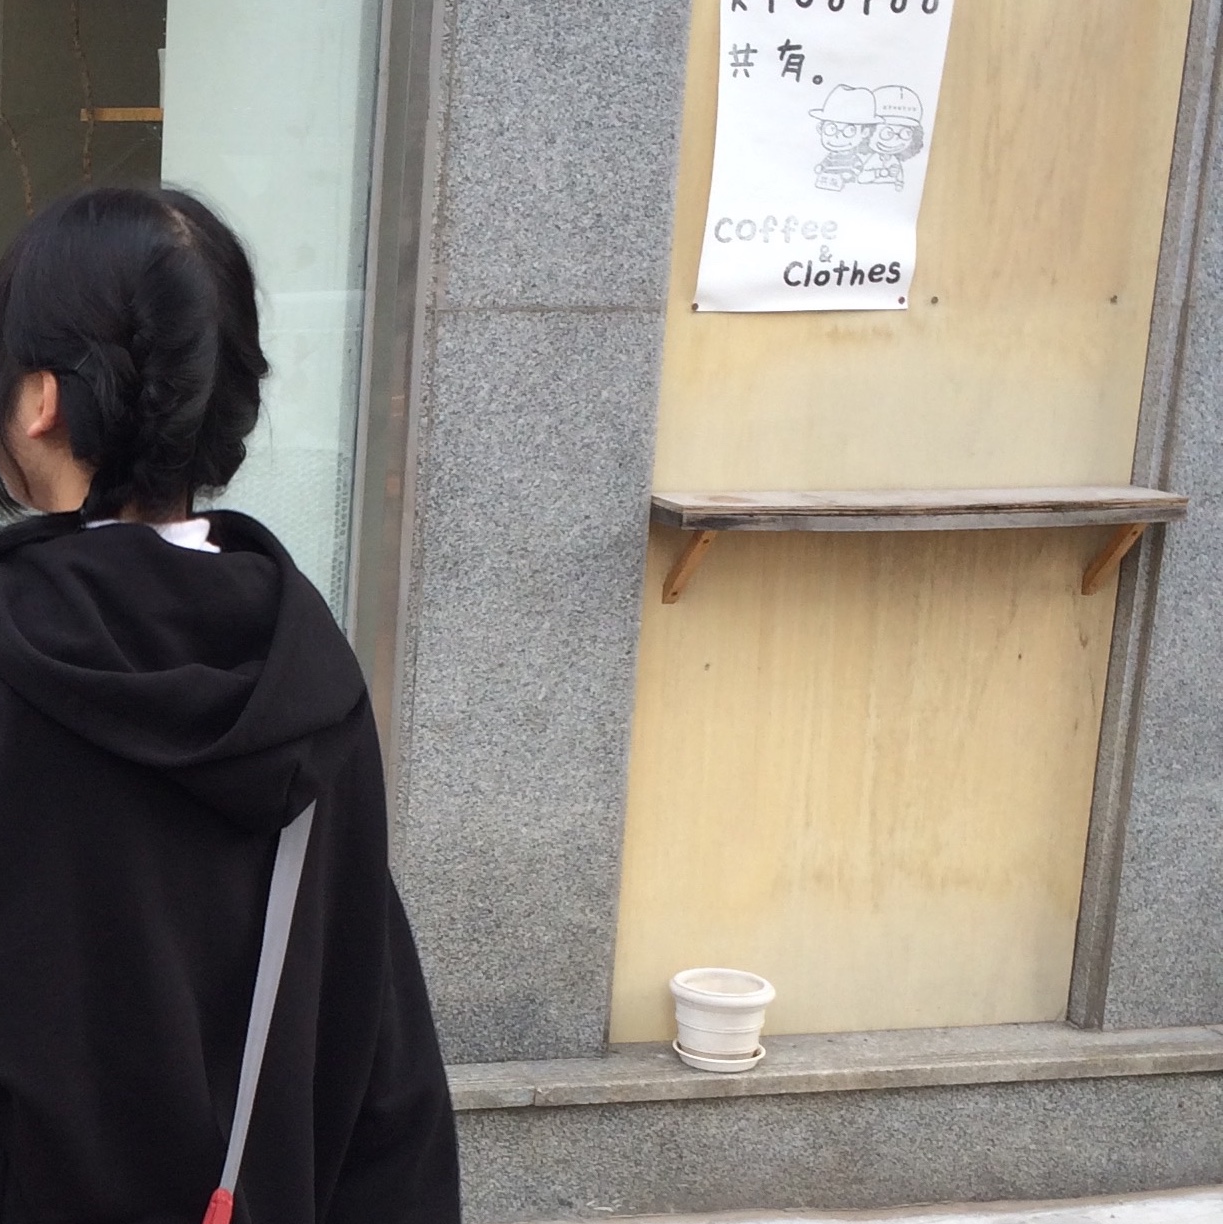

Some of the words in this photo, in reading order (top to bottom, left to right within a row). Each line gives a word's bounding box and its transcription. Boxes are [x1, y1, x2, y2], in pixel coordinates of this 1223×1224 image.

[714, 214, 838, 243] Coffee
[819, 244, 833, 263] &
[783, 260, 901, 287] Clothes
